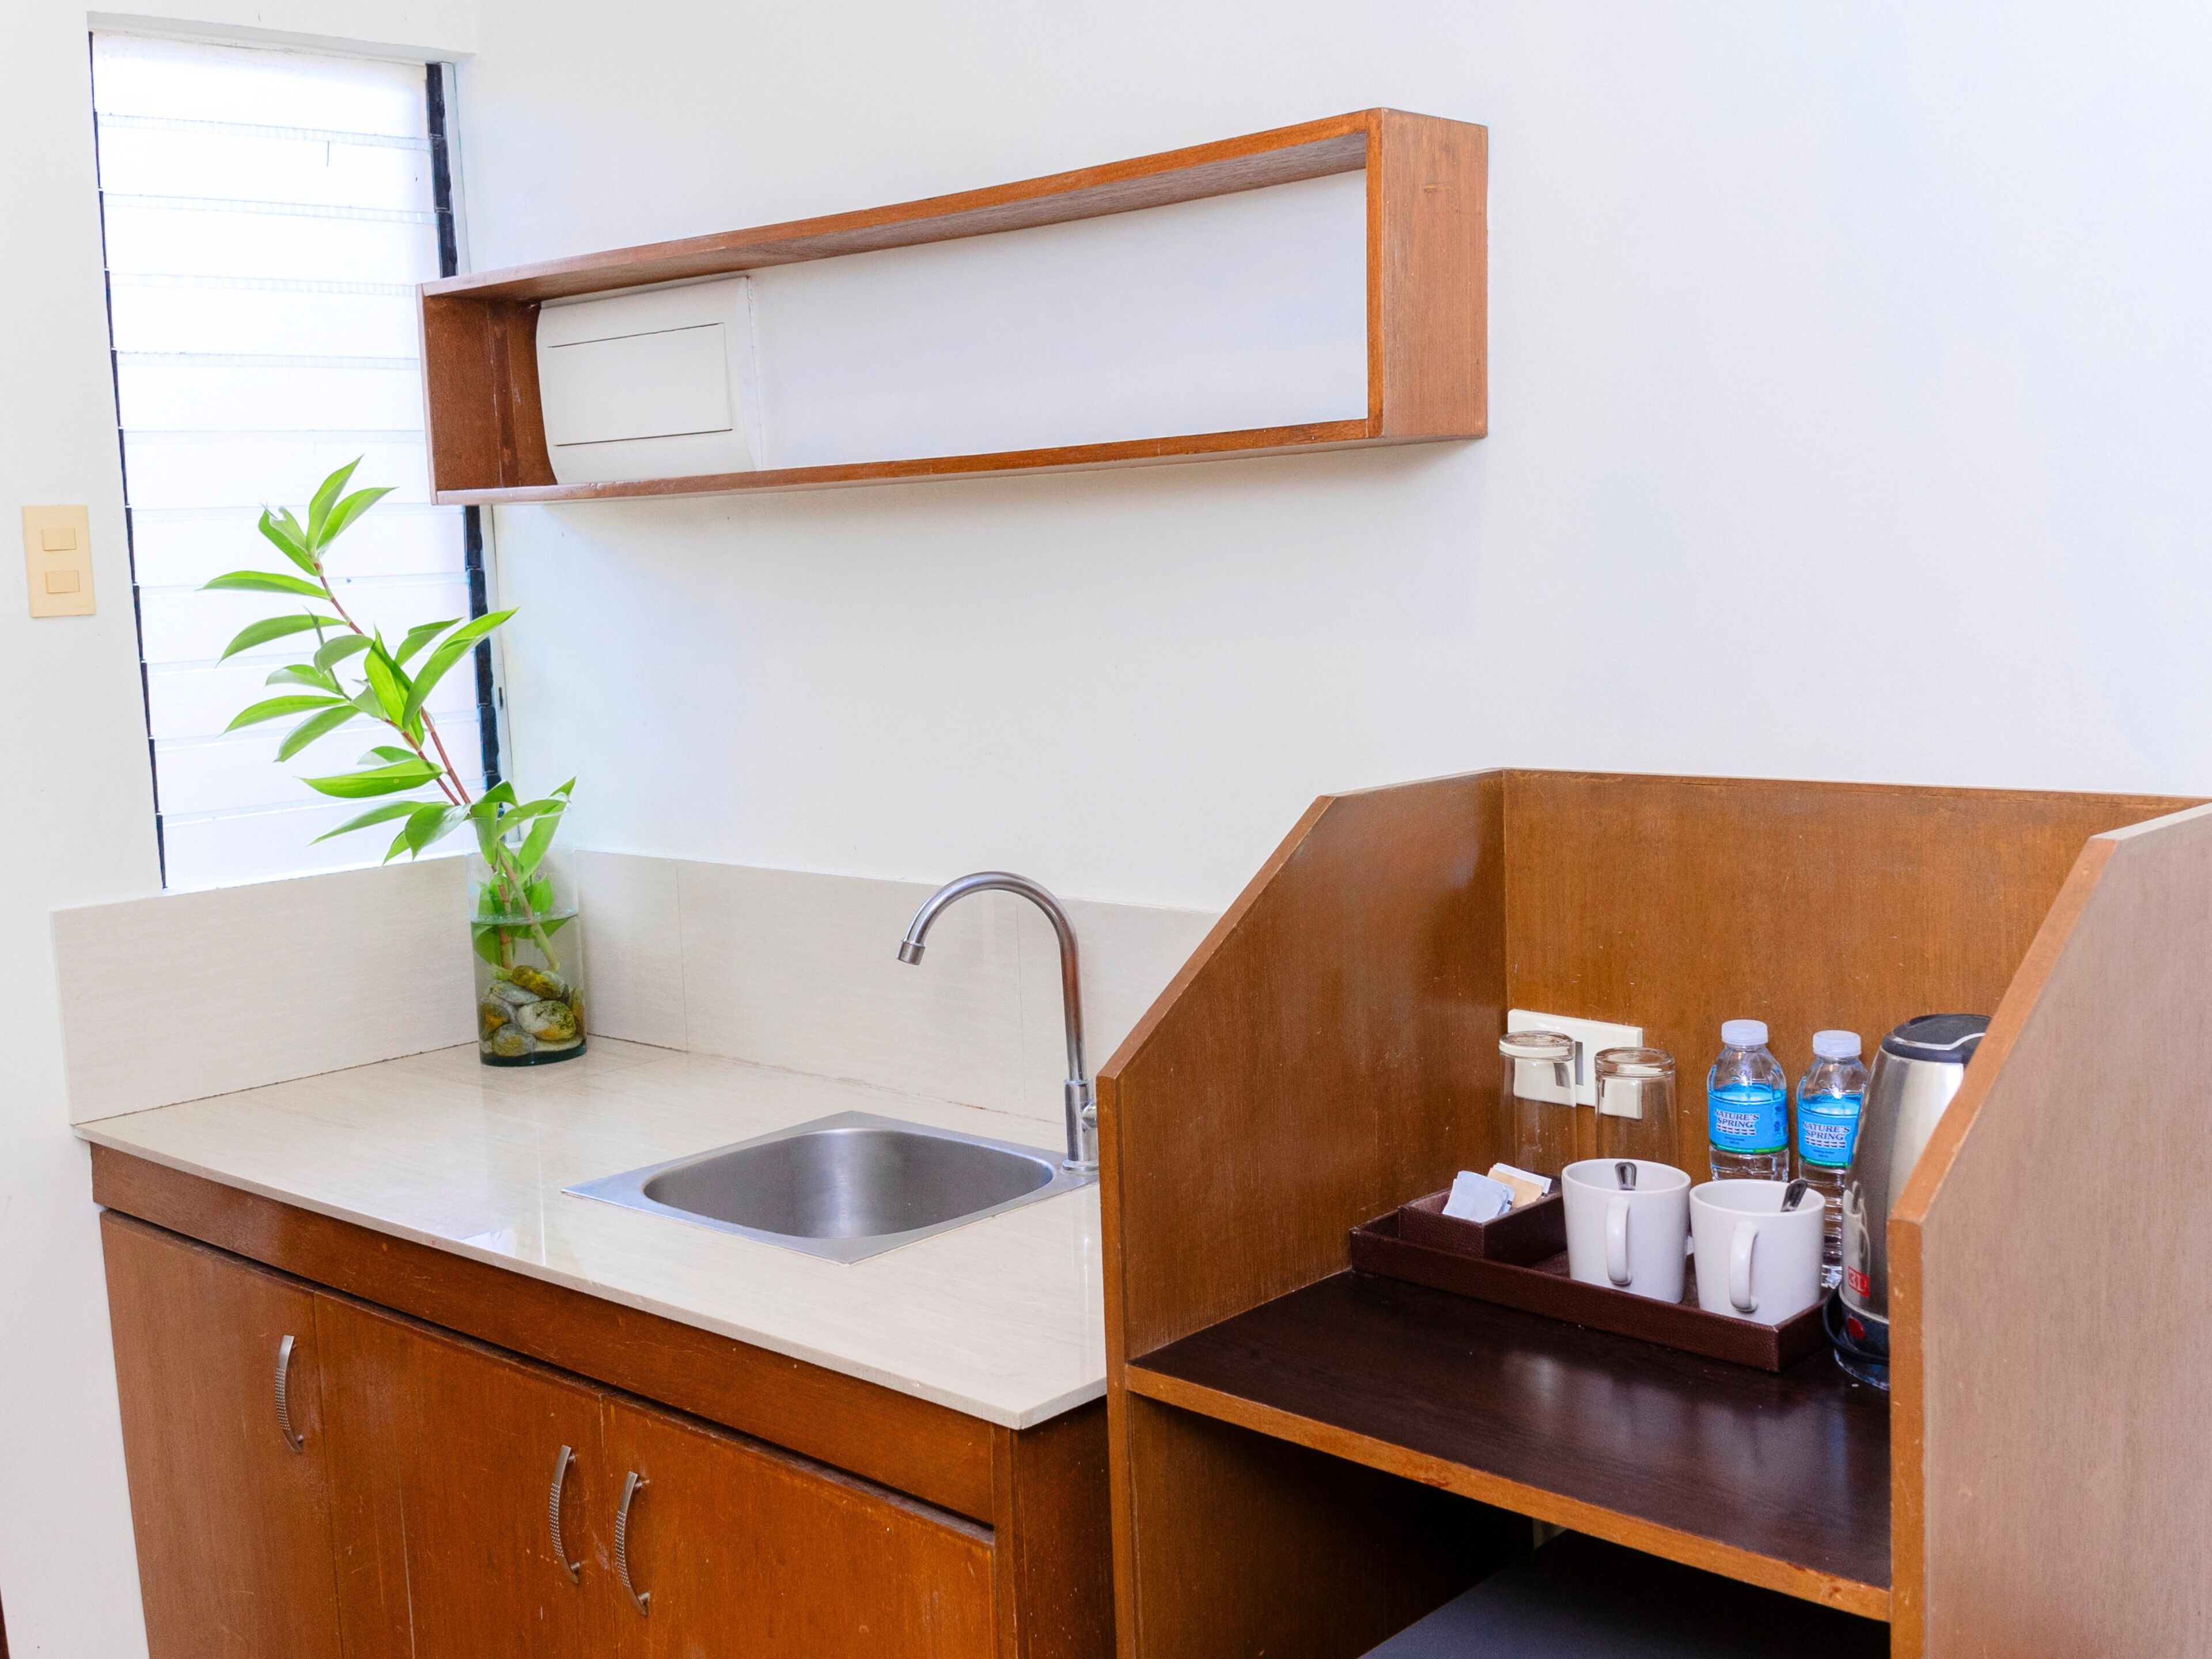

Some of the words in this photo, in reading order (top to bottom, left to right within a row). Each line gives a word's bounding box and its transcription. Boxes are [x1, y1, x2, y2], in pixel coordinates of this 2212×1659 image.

[1714, 1108, 1759, 1120] NATURE'S
[1717, 1117, 1753, 1128] SPRING
[1802, 1120, 1850, 1133] NATURE'S
[1805, 1129, 1845, 1140] SPRING
